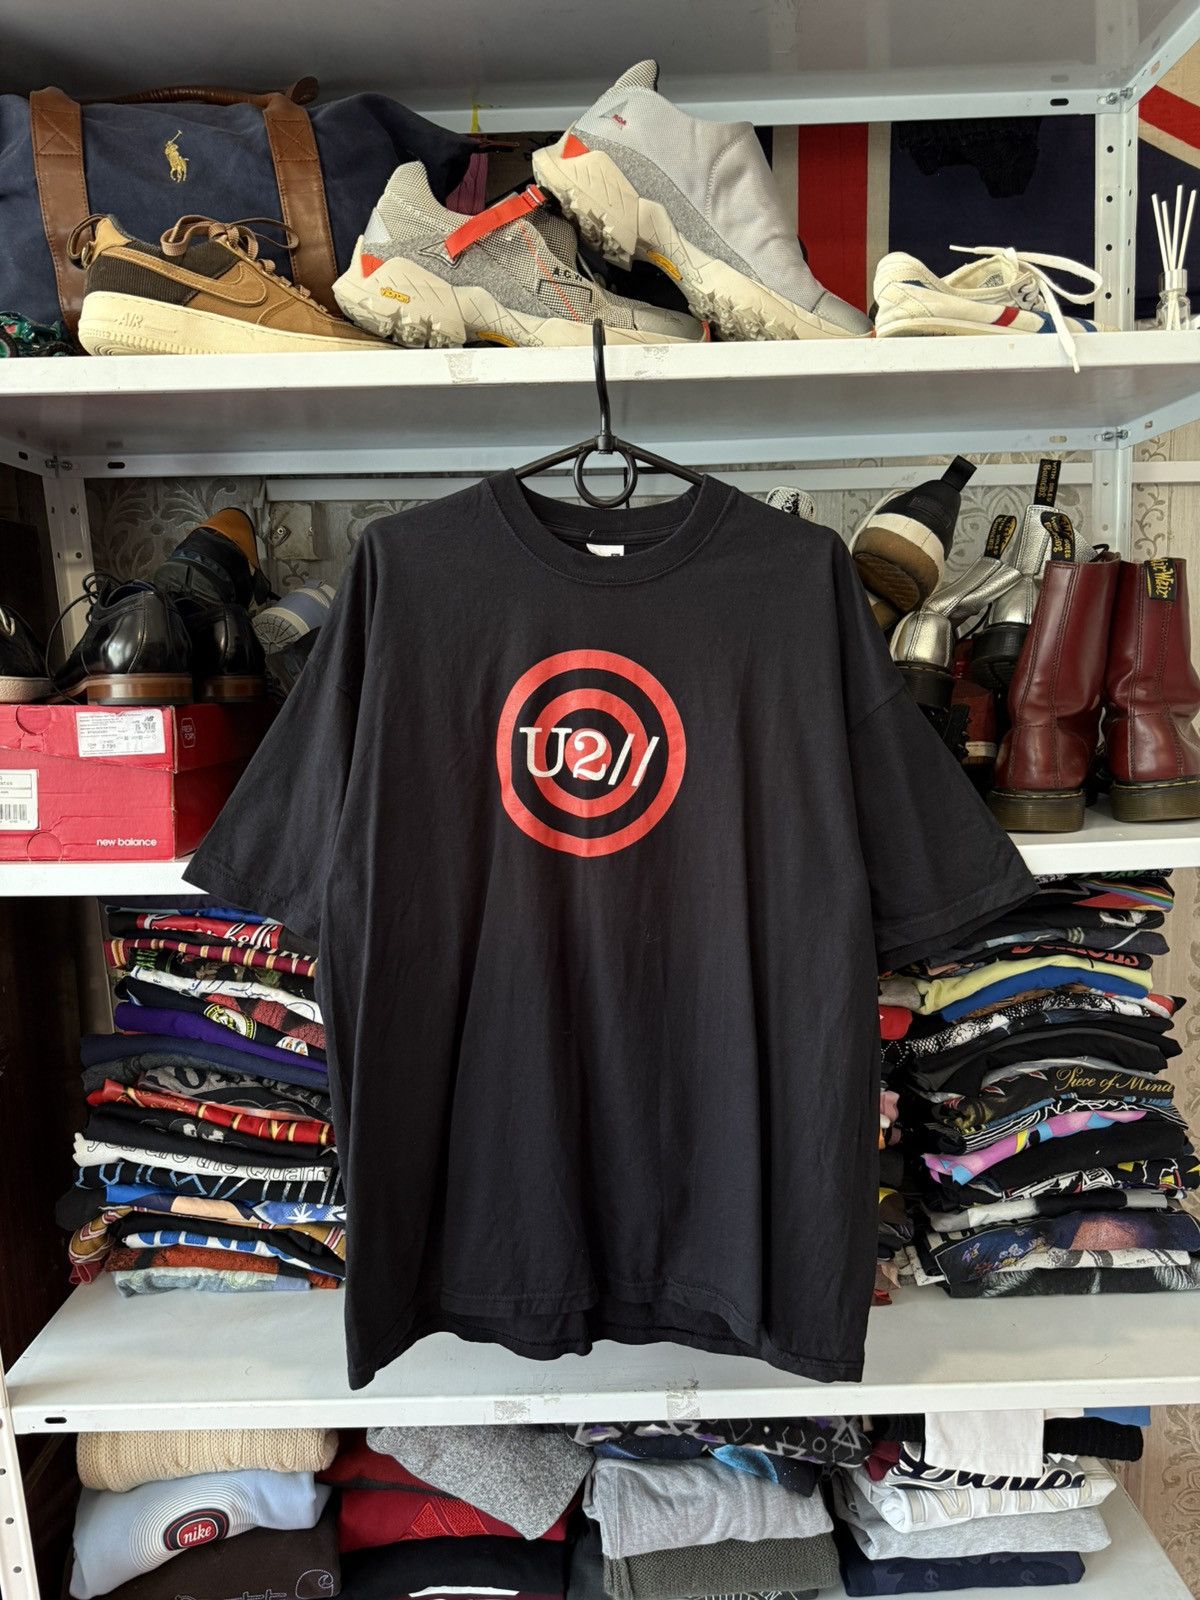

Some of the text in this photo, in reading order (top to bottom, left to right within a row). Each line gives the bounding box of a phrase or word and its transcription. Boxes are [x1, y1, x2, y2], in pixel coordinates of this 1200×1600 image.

[96, 837, 158, 847] new balance
[1054, 1063, 1097, 1092] Piece
[1099, 1072, 1122, 1095] of
[182, 1523, 212, 1544] nike
